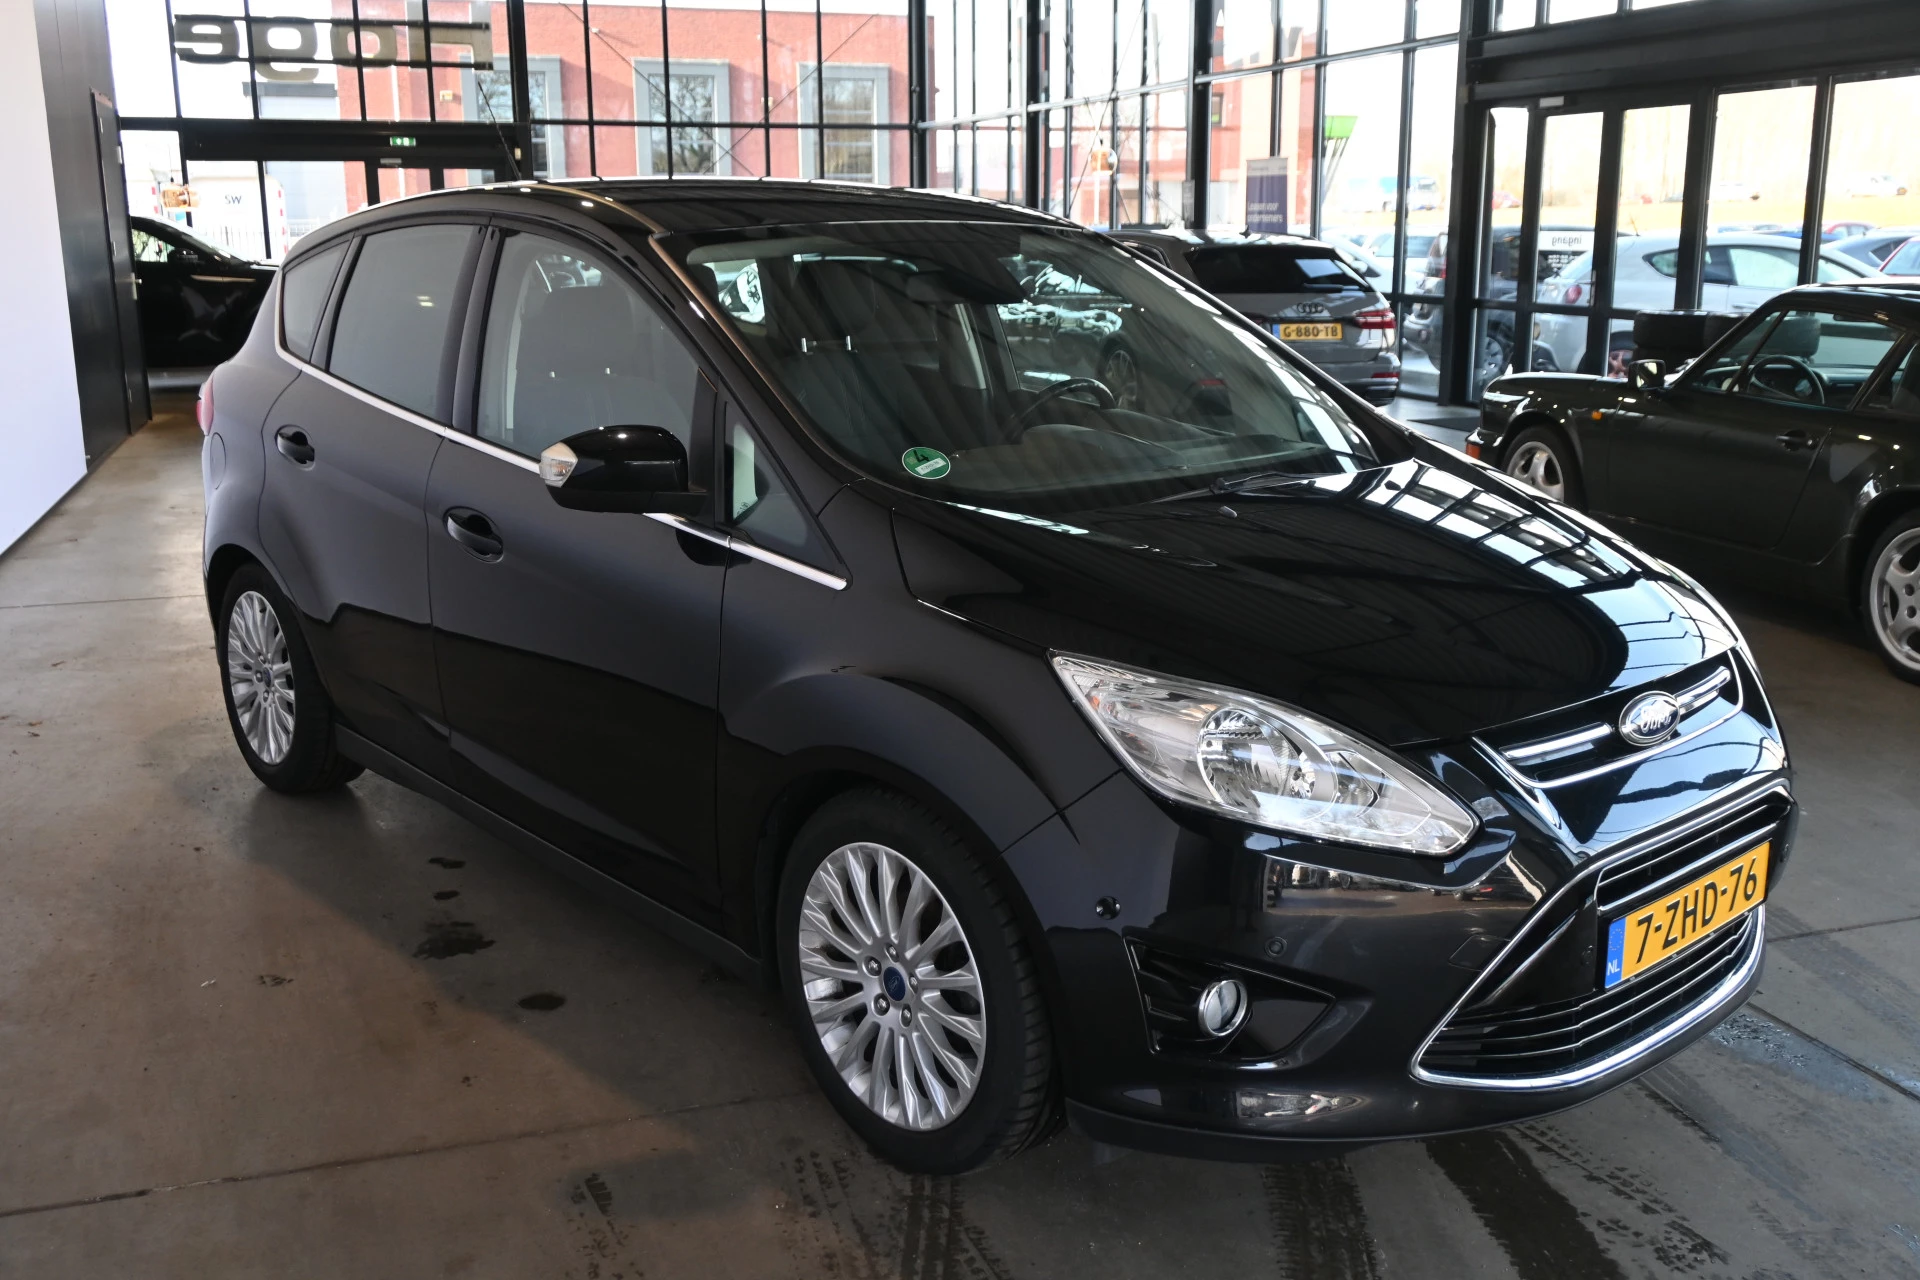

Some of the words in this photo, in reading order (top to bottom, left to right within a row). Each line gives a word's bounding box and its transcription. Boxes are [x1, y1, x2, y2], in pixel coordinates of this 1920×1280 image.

[1283, 325, 1339, 338] G-880-TB
[1636, 856, 1758, 965] 7-ZHD-76
[1607, 959, 1621, 976] NL
